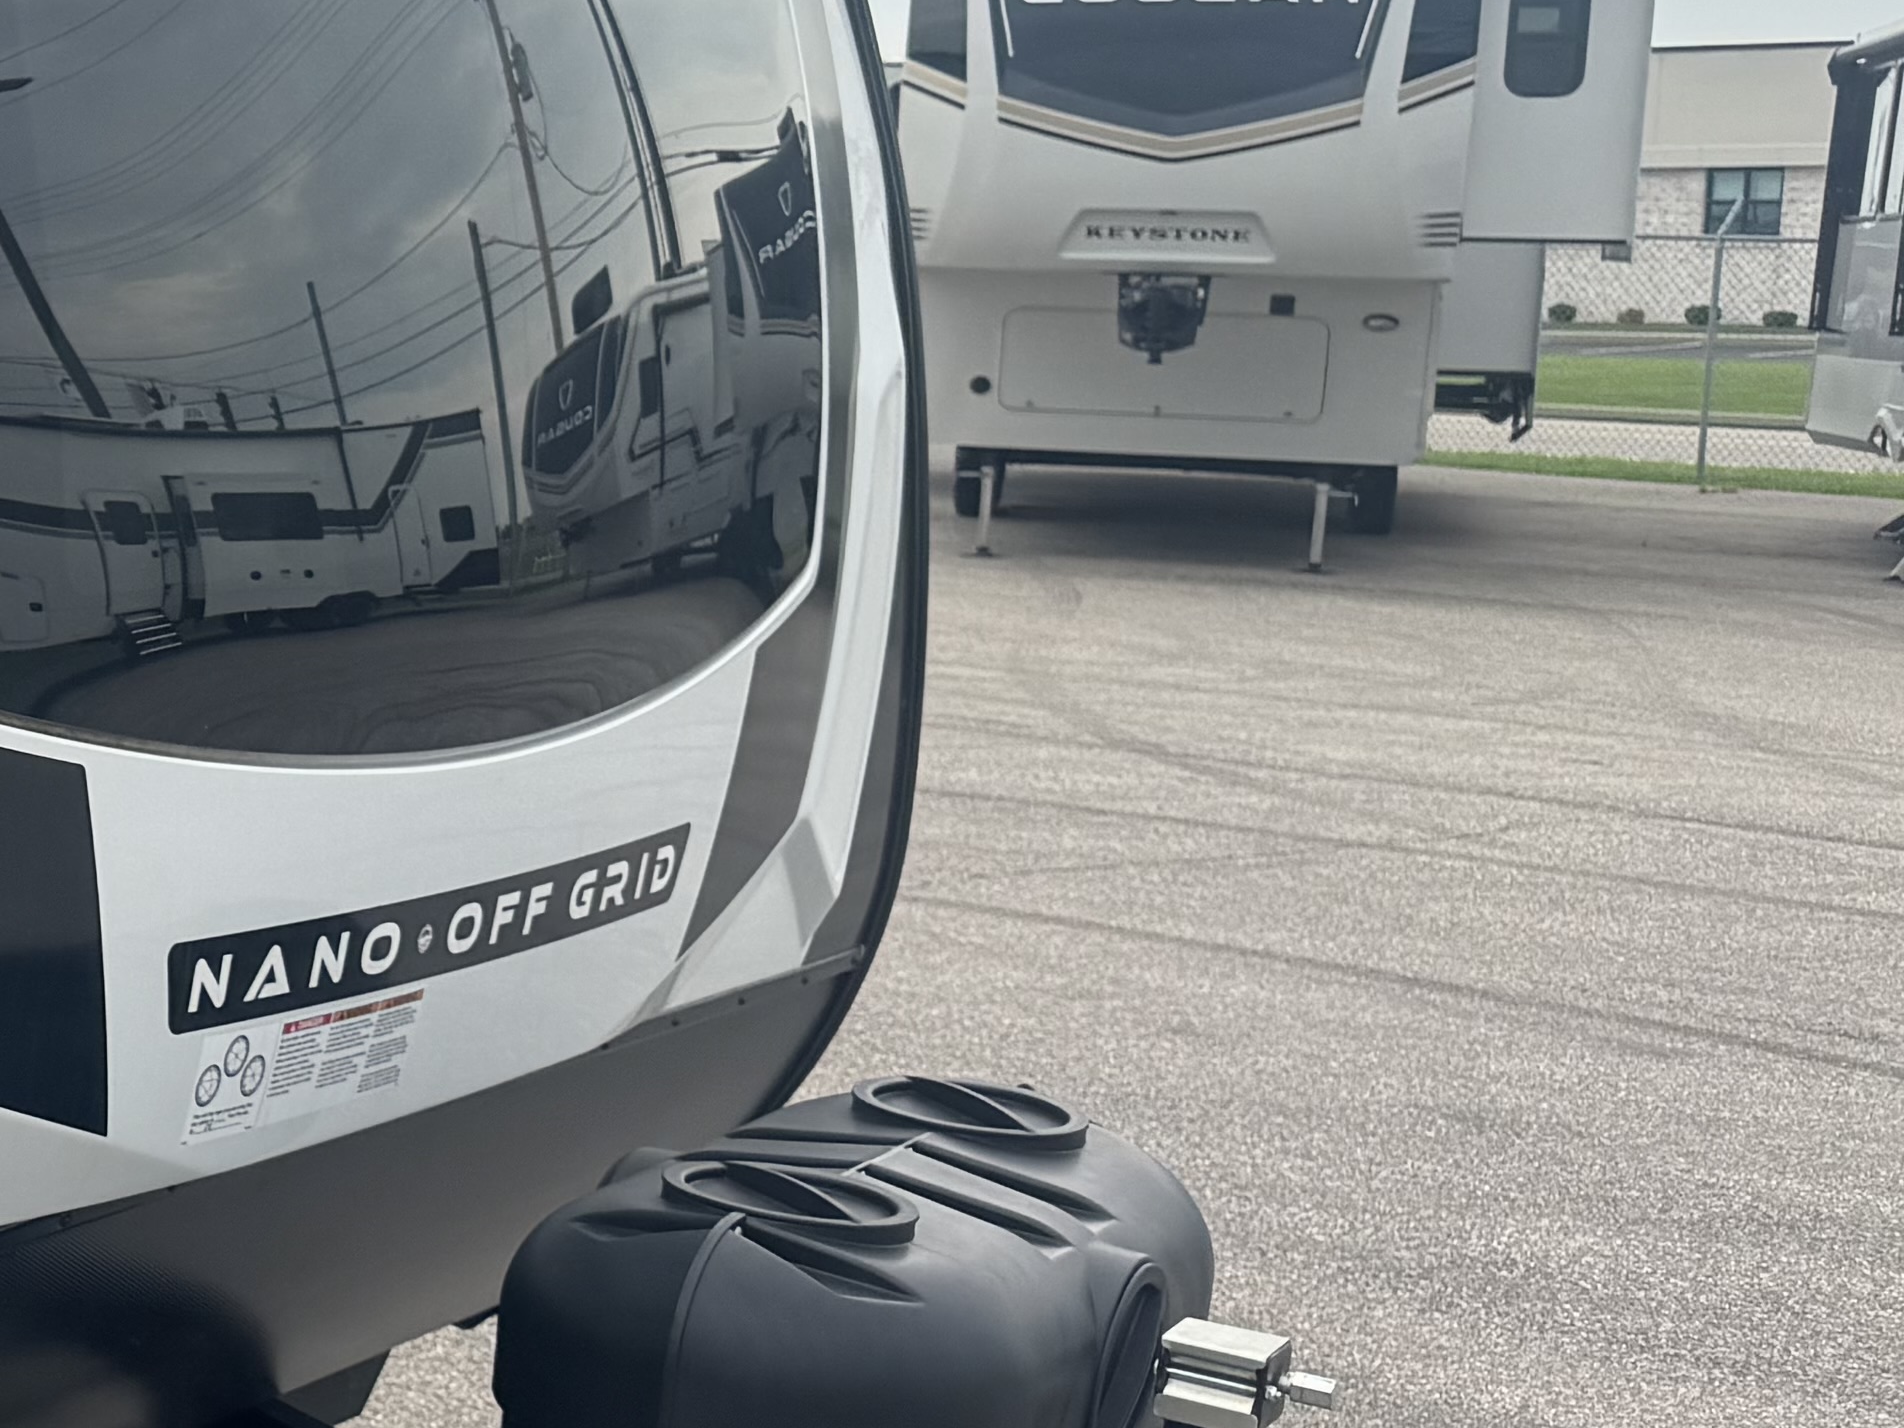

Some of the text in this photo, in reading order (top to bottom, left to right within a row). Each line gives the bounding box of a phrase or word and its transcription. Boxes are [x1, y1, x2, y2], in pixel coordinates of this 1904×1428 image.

[1084, 224, 1251, 244] KEYSTONE
[187, 844, 678, 1014] NANO OFF GRID
